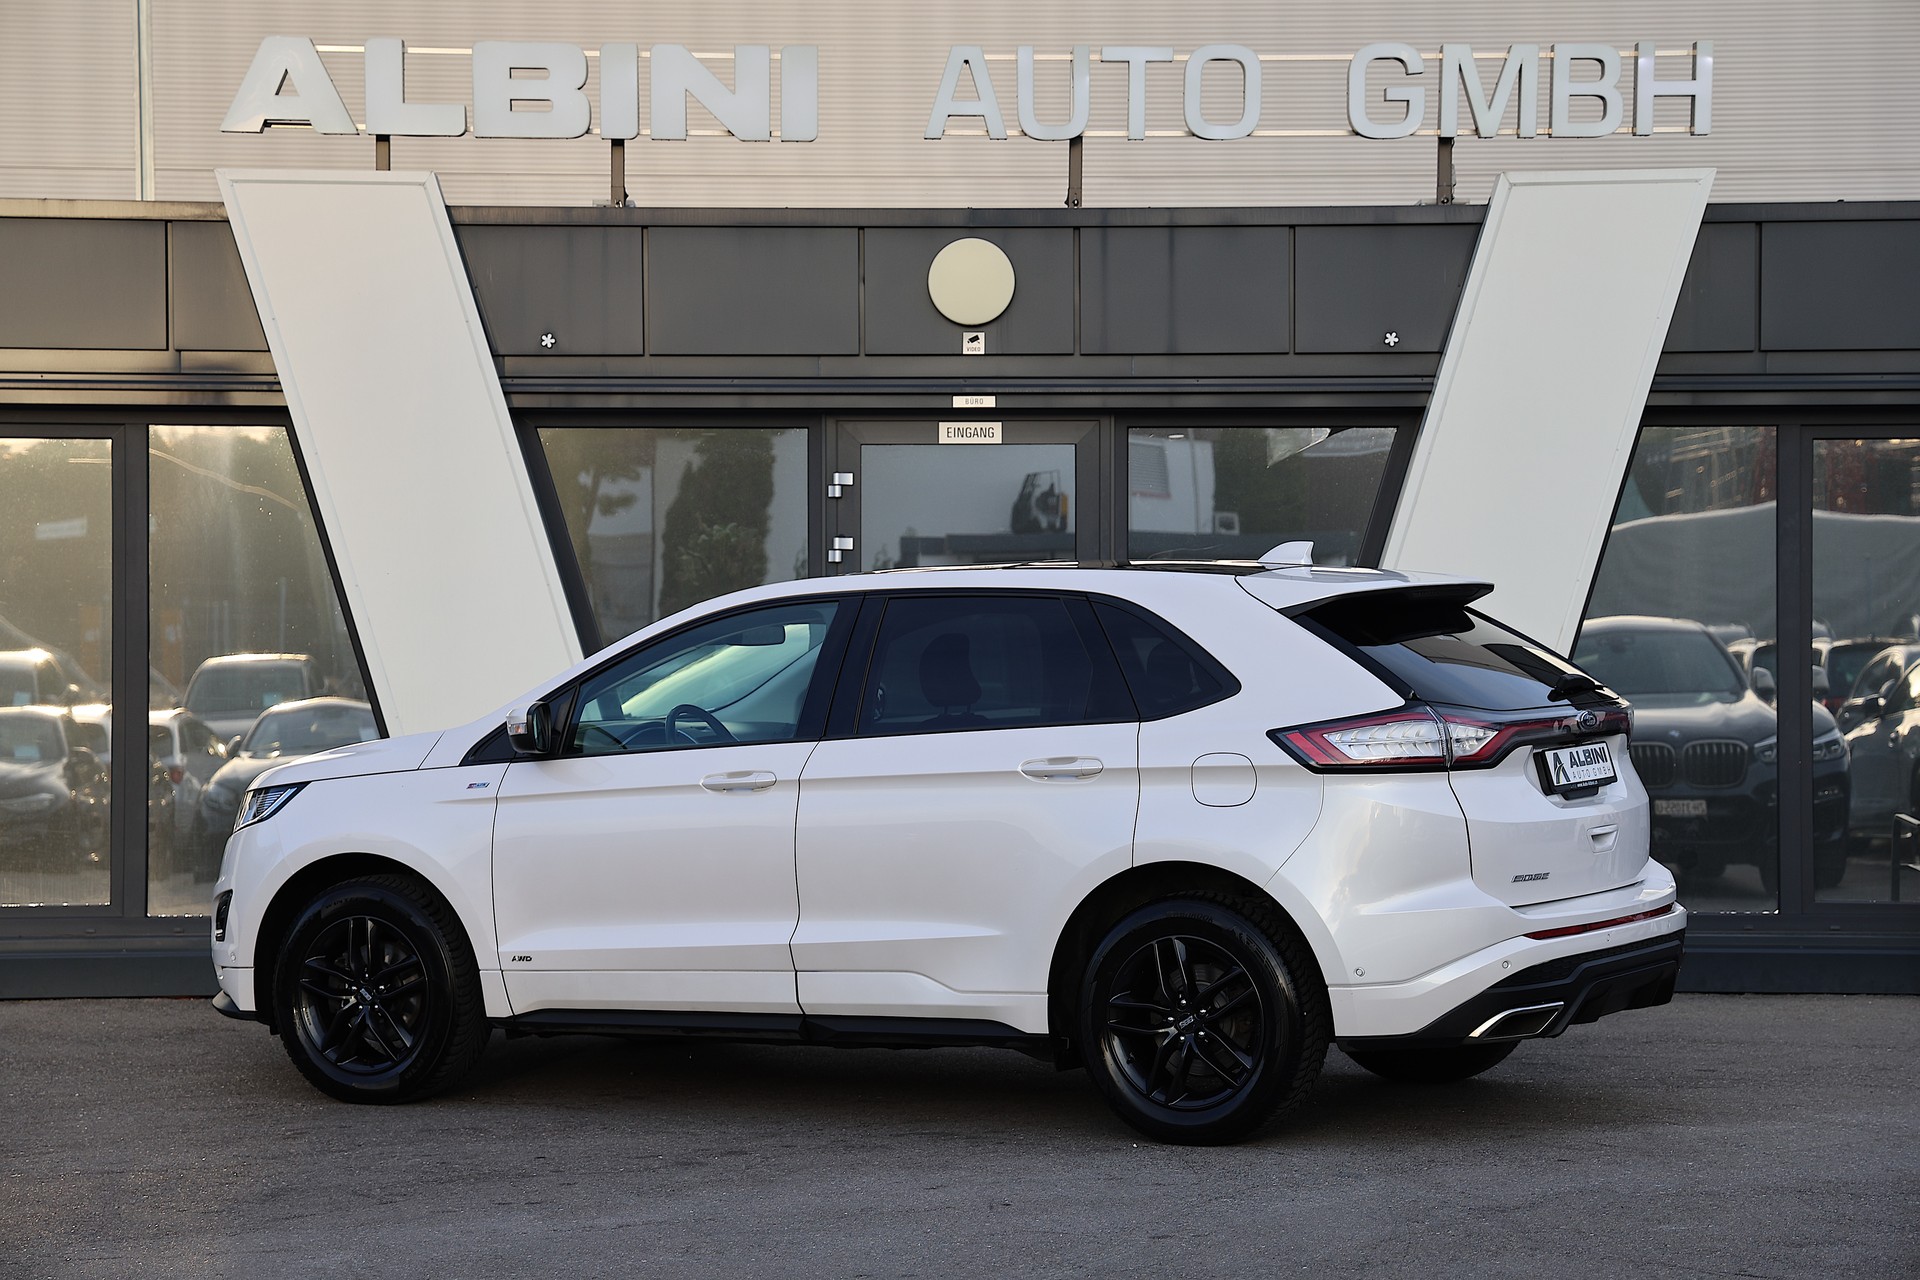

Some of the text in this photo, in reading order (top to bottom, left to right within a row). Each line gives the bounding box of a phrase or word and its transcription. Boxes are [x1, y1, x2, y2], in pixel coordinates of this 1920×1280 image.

[220, 36, 1714, 142] ALBINI AUTO GMBH
[965, 397, 984, 405] BÜRO
[946, 426, 995, 439] EINGANG
[1569, 747, 1608, 768] ALBINI
[1572, 766, 1612, 780] AUTO GMBH
